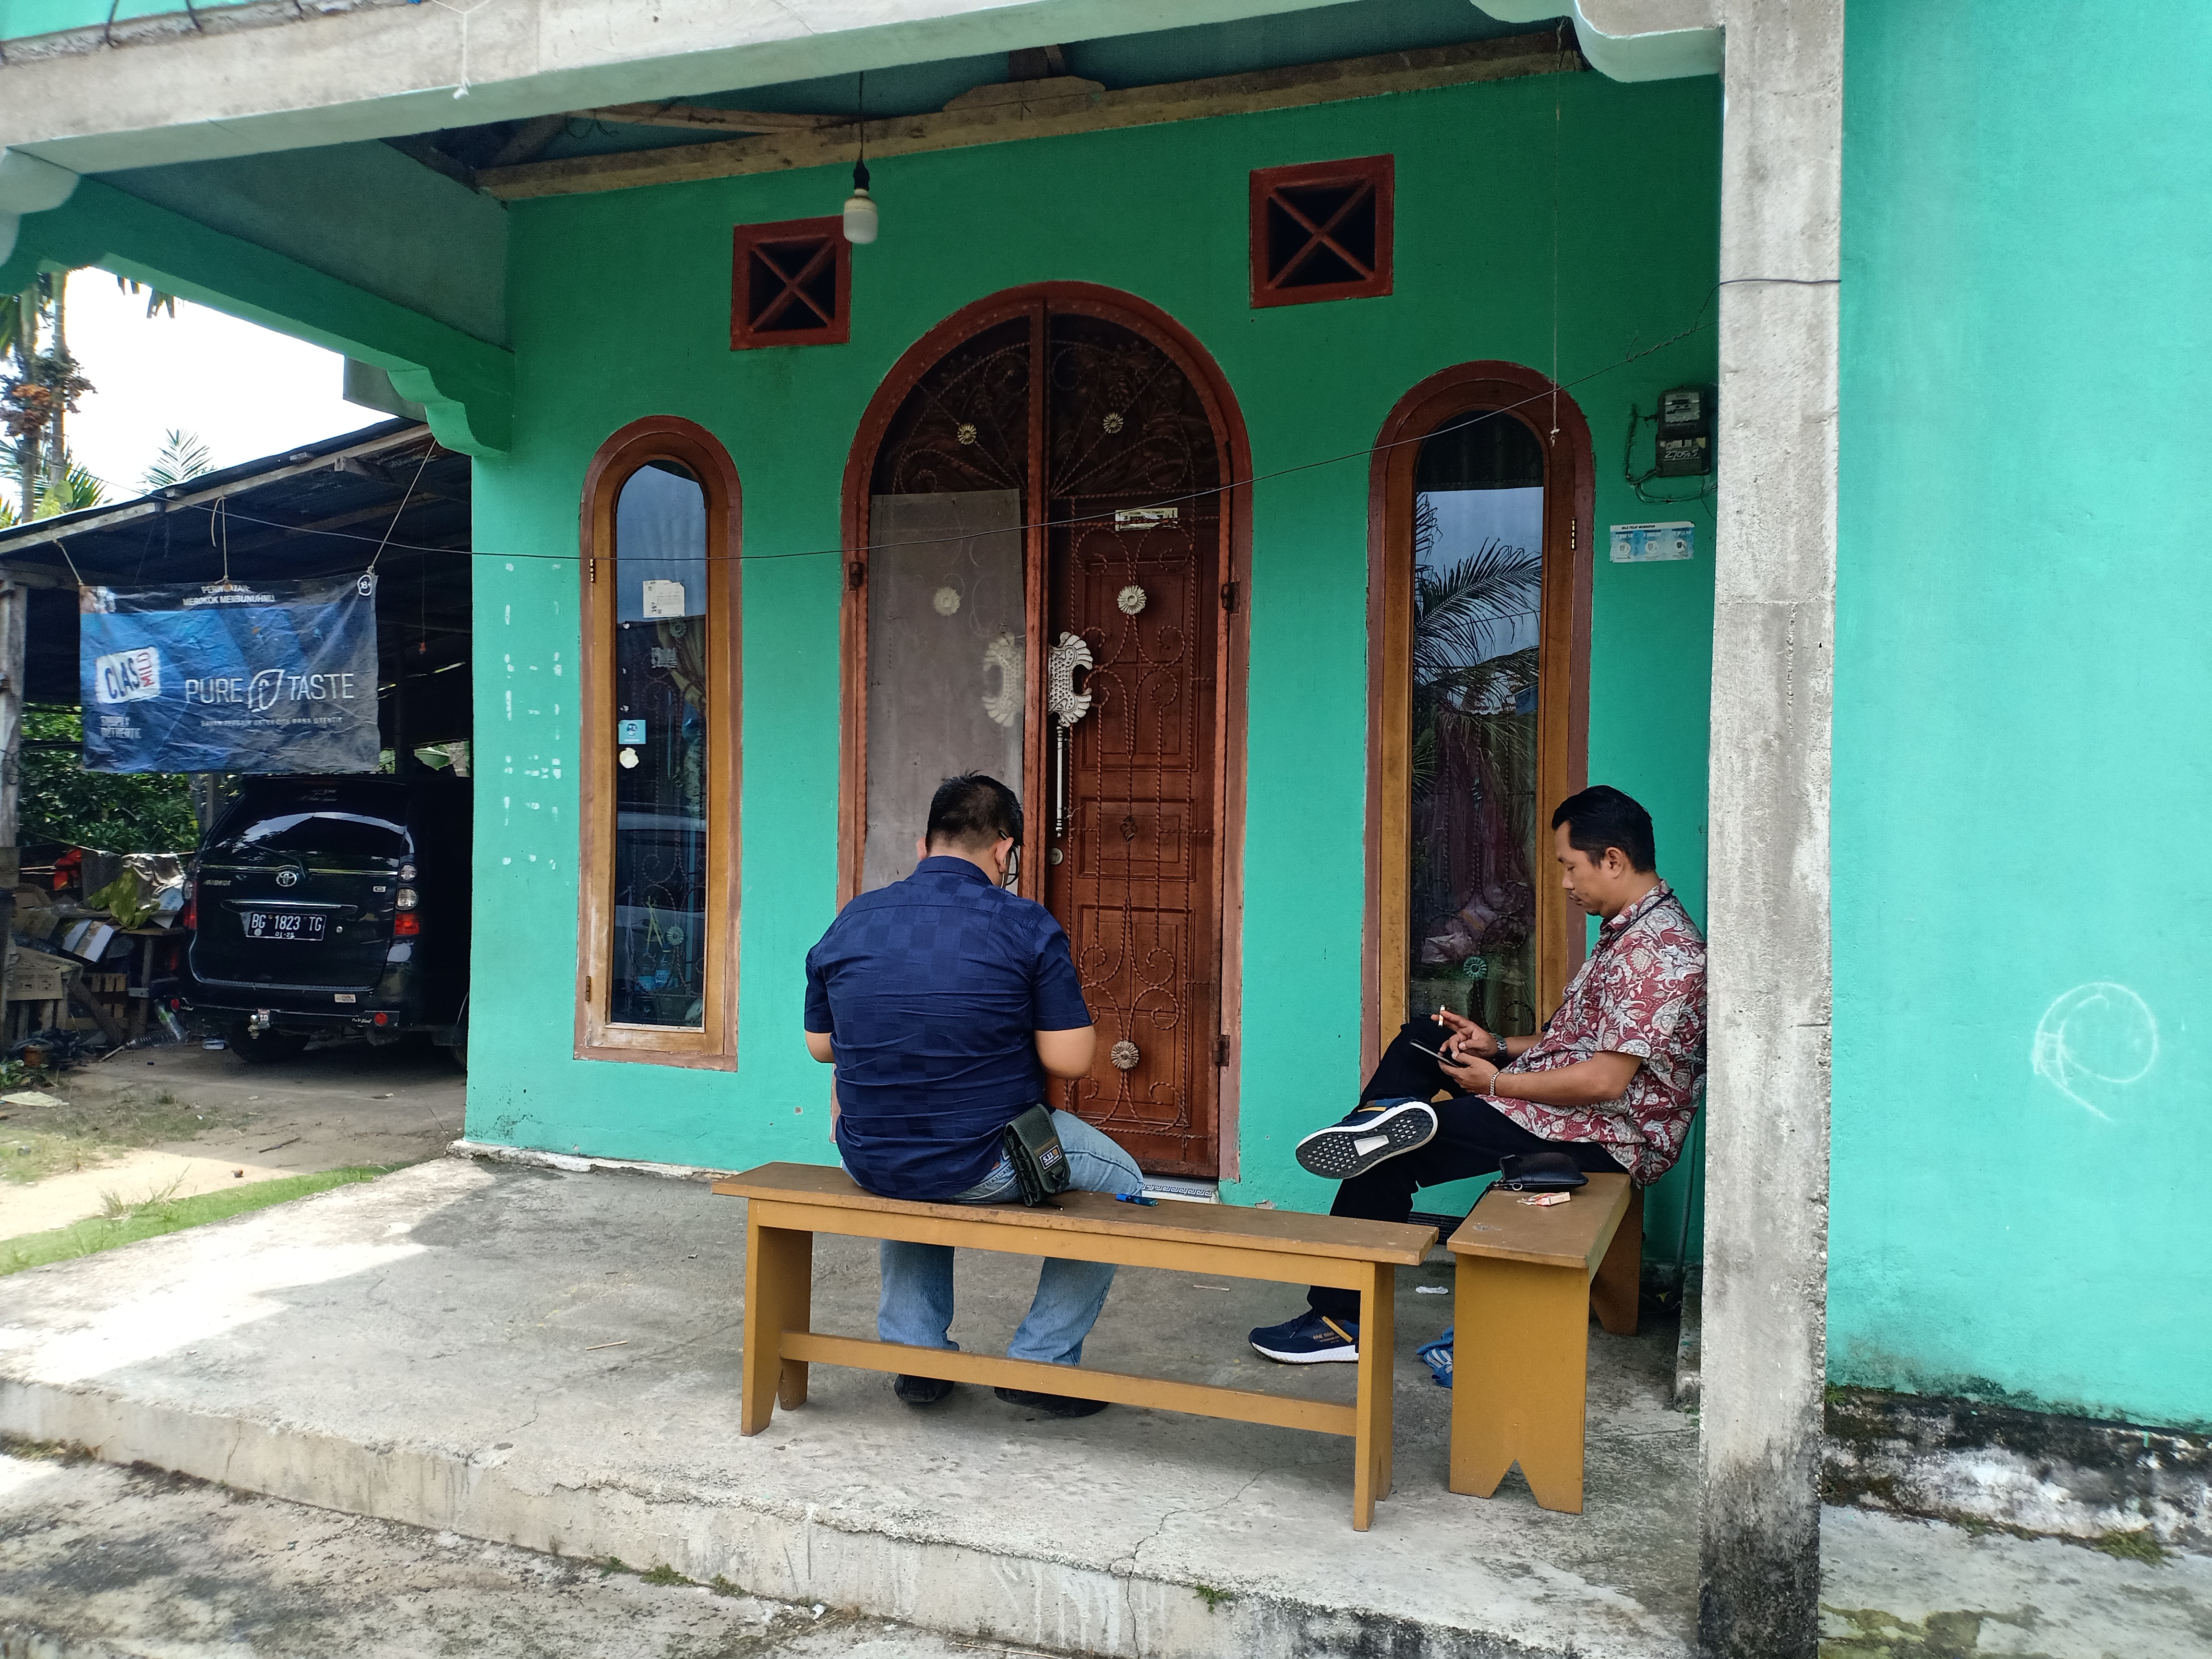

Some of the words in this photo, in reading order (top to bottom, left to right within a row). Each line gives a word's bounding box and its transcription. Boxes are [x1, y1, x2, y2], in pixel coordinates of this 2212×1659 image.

[182, 596, 218, 606] MEROKOK
[136, 652, 156, 688] MILD
[185, 677, 244, 704] PURE
[287, 673, 354, 700] TASTE
[251, 914, 266, 928] BG
[274, 915, 301, 930] 1823
[309, 916, 323, 931] TG
